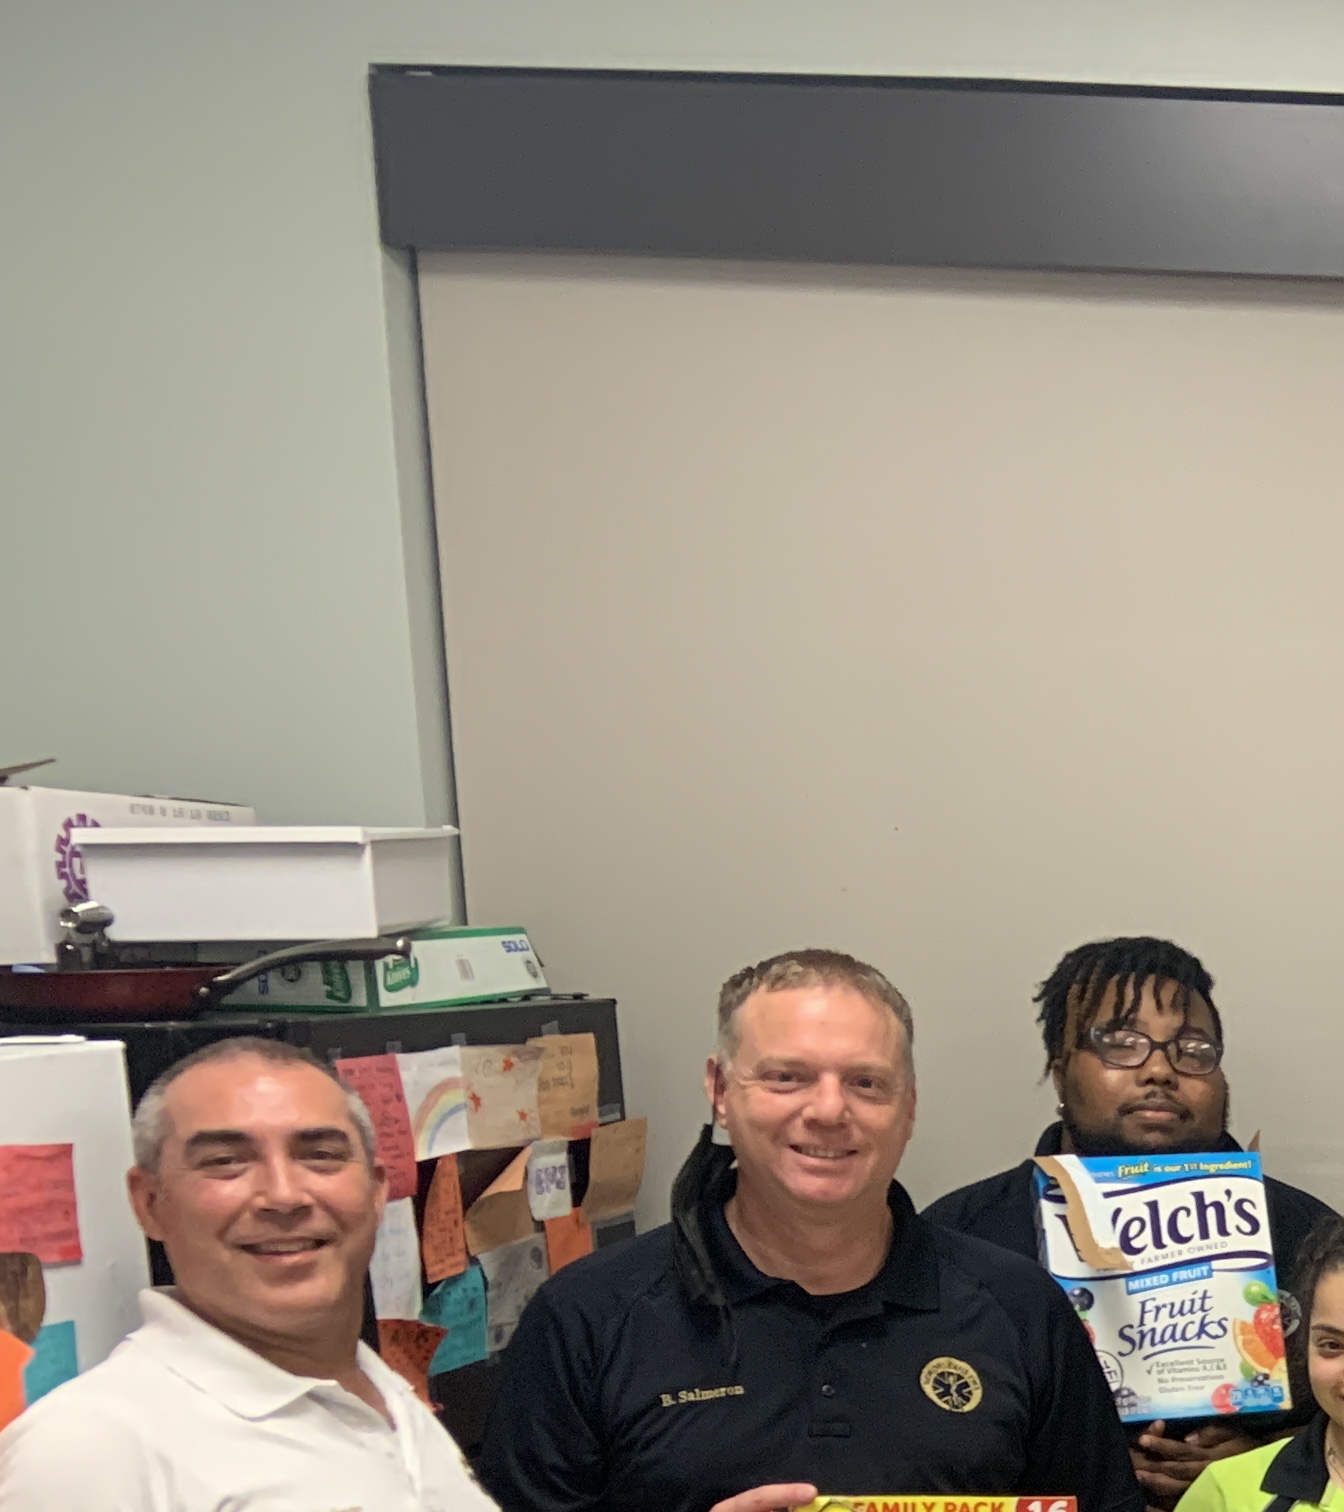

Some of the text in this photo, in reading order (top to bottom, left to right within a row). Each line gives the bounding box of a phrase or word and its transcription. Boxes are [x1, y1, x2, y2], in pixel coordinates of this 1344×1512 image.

[501, 939, 530, 954] SOLO
[1117, 1162, 1150, 1179] Fruit
[1164, 1163, 1183, 1173] our
[1139, 1240, 1229, 1266] FARMER OWNED
[1126, 1264, 1212, 1292] MIXED FRUIT
[1136, 1288, 1215, 1329] Fruit
[1116, 1312, 1230, 1358] Snacks
